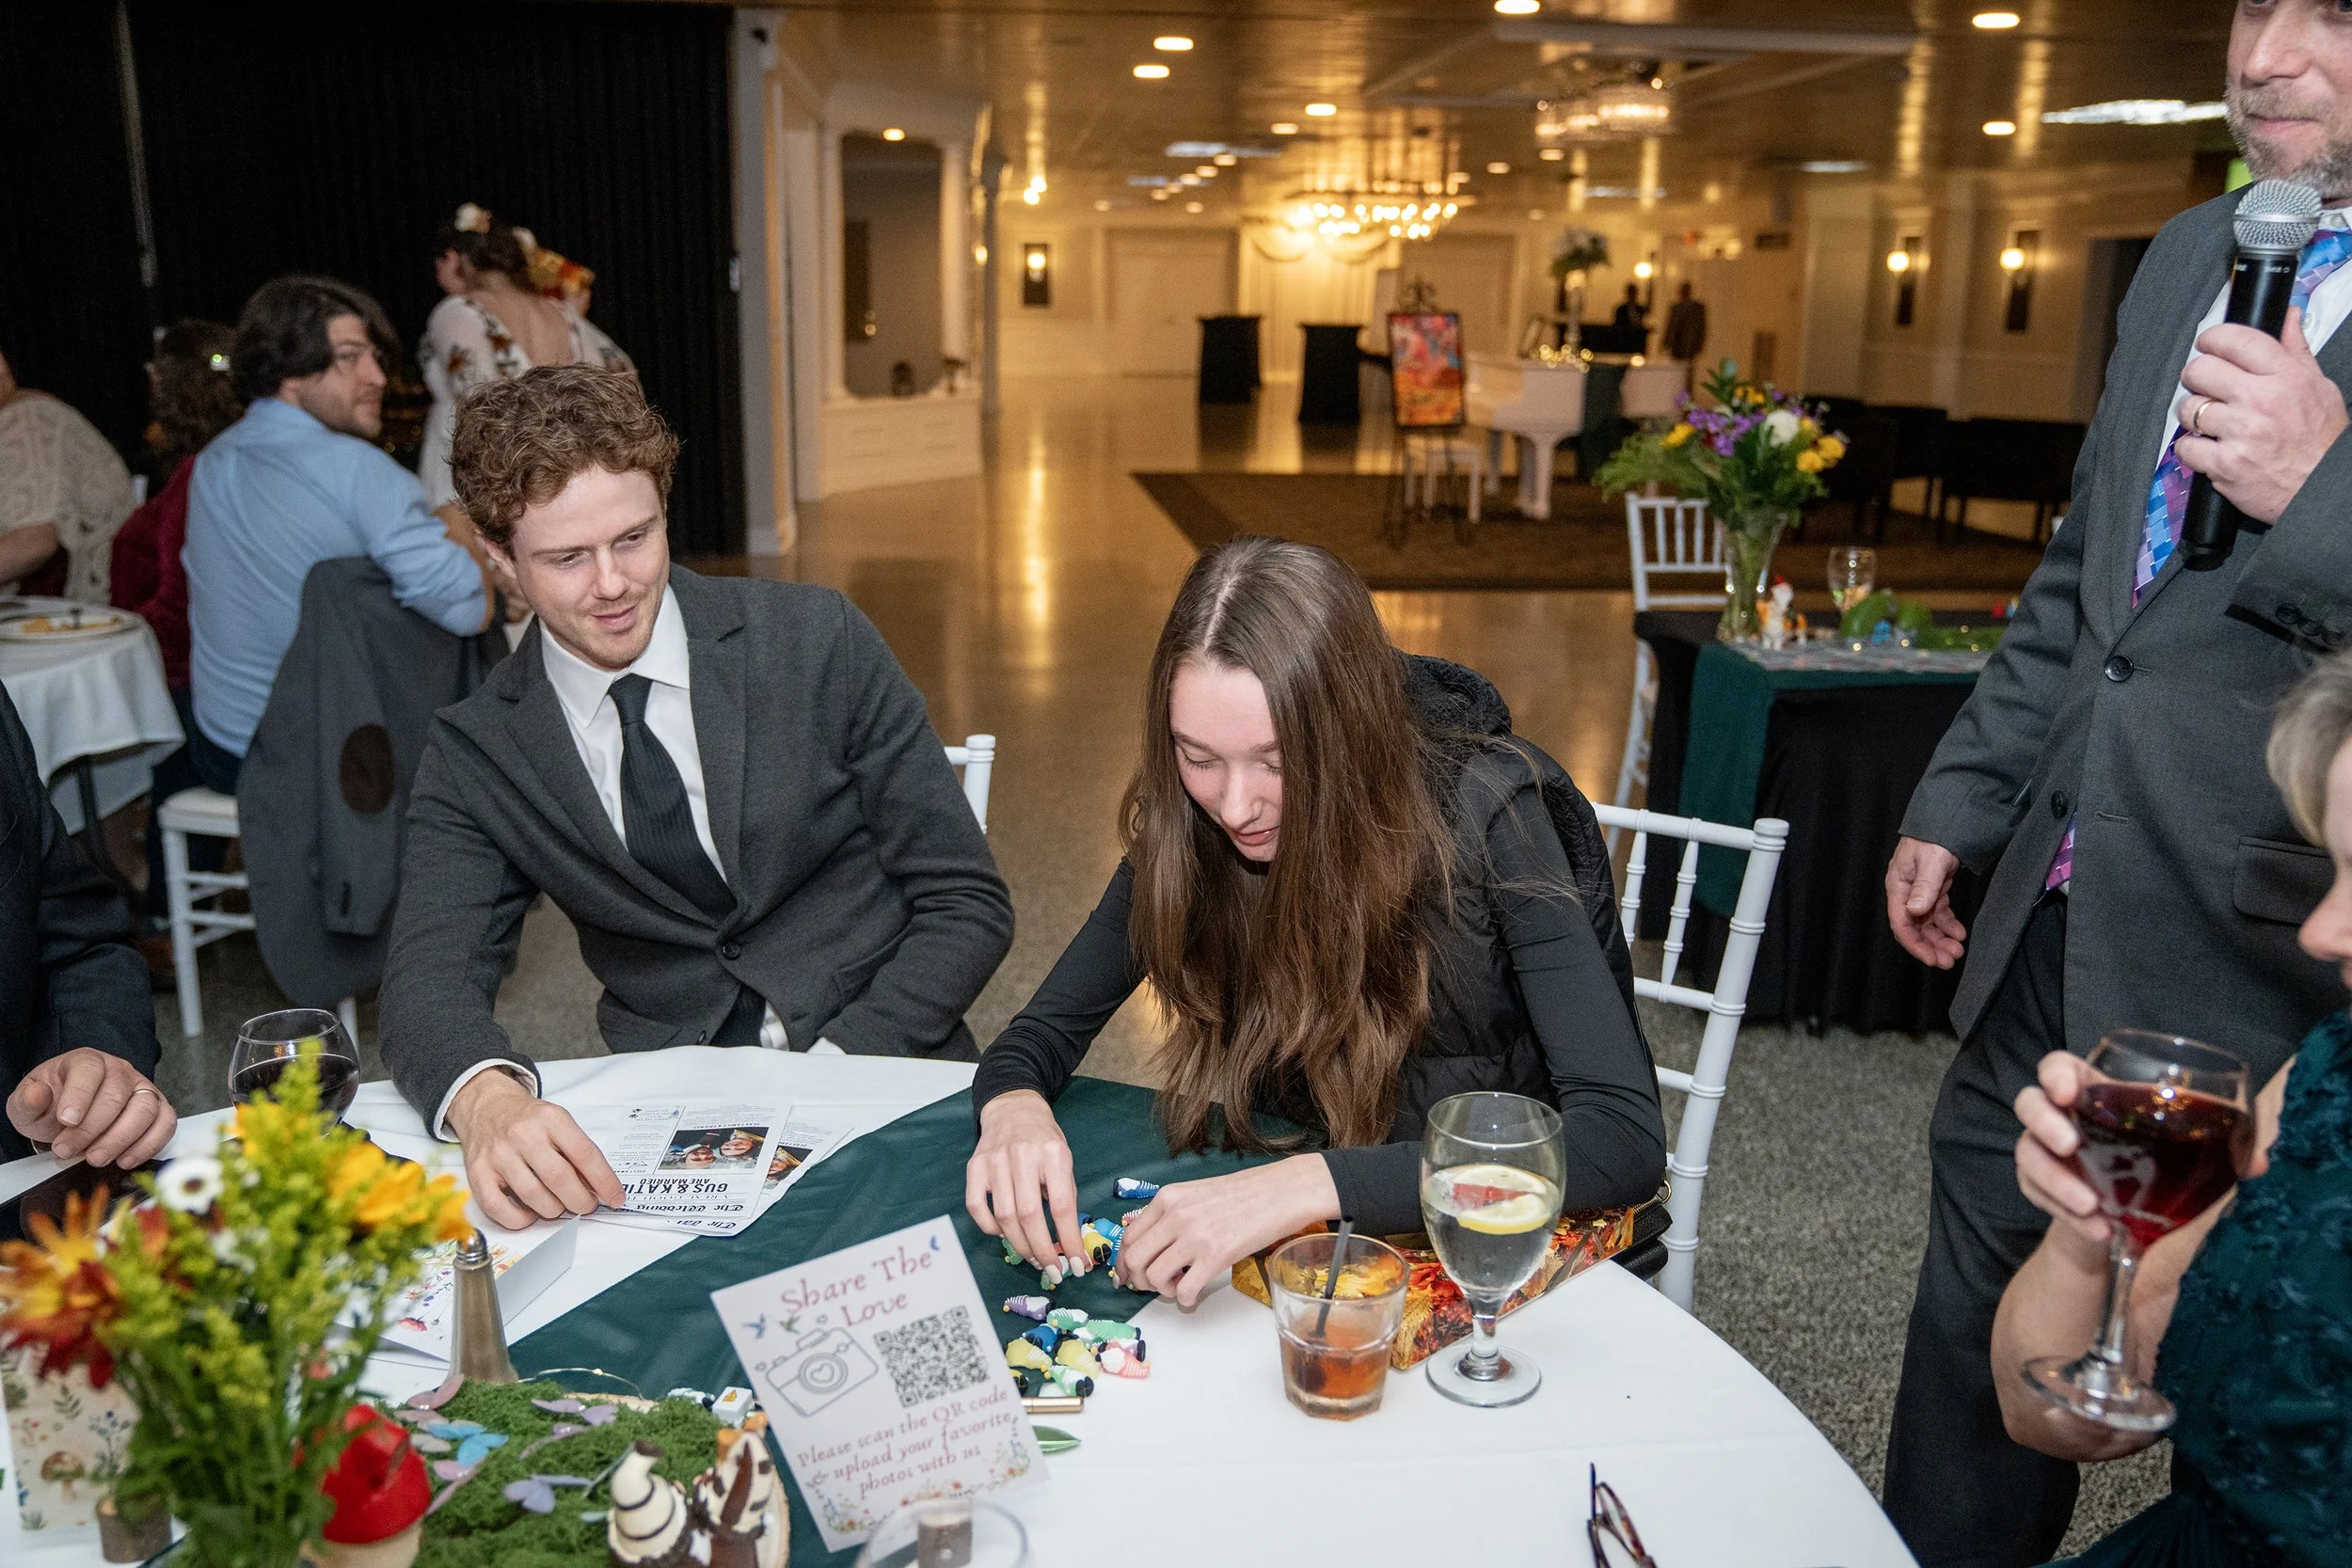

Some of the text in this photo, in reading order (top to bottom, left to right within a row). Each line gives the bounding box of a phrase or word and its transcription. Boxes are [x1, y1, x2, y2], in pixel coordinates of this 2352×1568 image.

[676, 1183, 690, 1194] &
[692, 1182, 729, 1193] GUS
[780, 1245, 933, 1314] Share The
[841, 1292, 909, 1326] Love
[796, 1385, 1008, 1467] Please scan the QR code
[834, 1443, 893, 1481] upload
[896, 1434, 935, 1465] your
[942, 1413, 1011, 1455] favorite
[860, 1446, 981, 1501] photos with us
